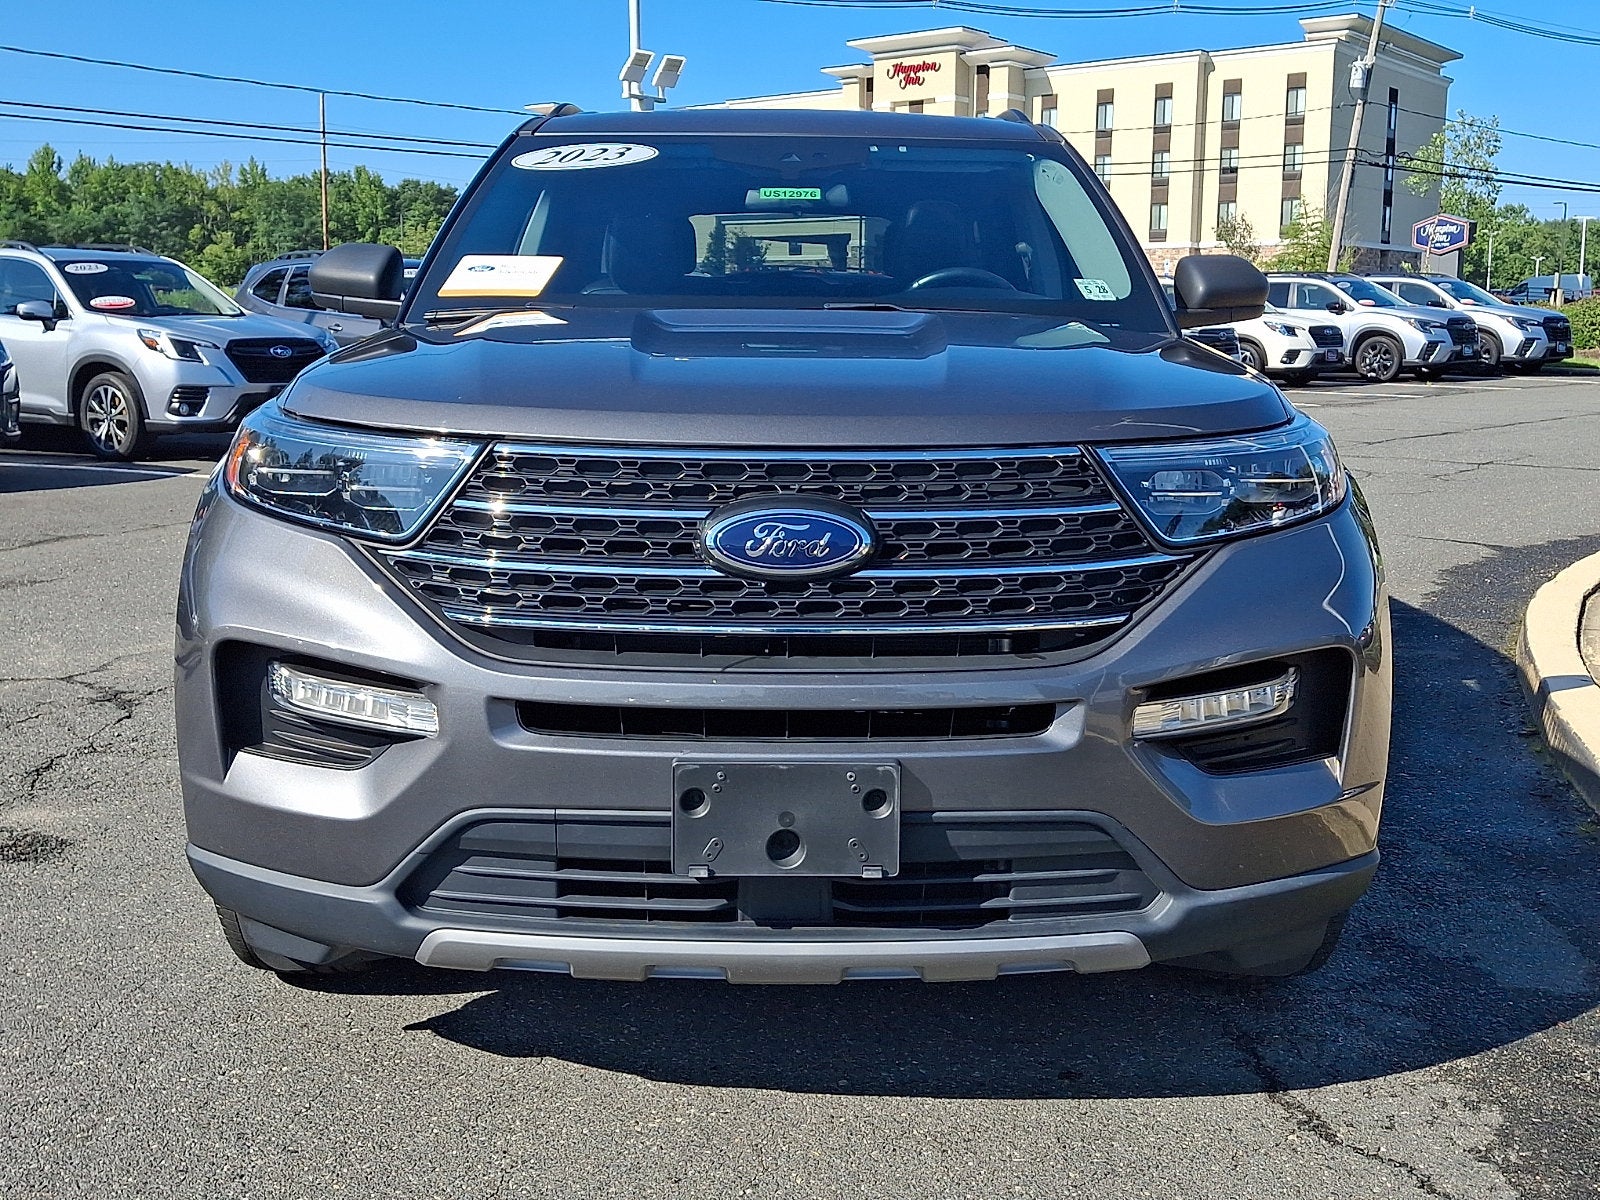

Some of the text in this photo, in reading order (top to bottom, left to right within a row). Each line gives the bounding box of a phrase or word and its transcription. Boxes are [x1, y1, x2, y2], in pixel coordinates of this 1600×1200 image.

[887, 61, 941, 79] Hampton
[899, 73, 925, 90] Inn
[532, 147, 632, 166] 2023
[763, 190, 817, 199] US12976
[1420, 223, 1460, 236] Hmpton
[74, 264, 99, 272] 2023
[1084, 285, 1109, 294] 5 28
[745, 521, 832, 558] Ford
